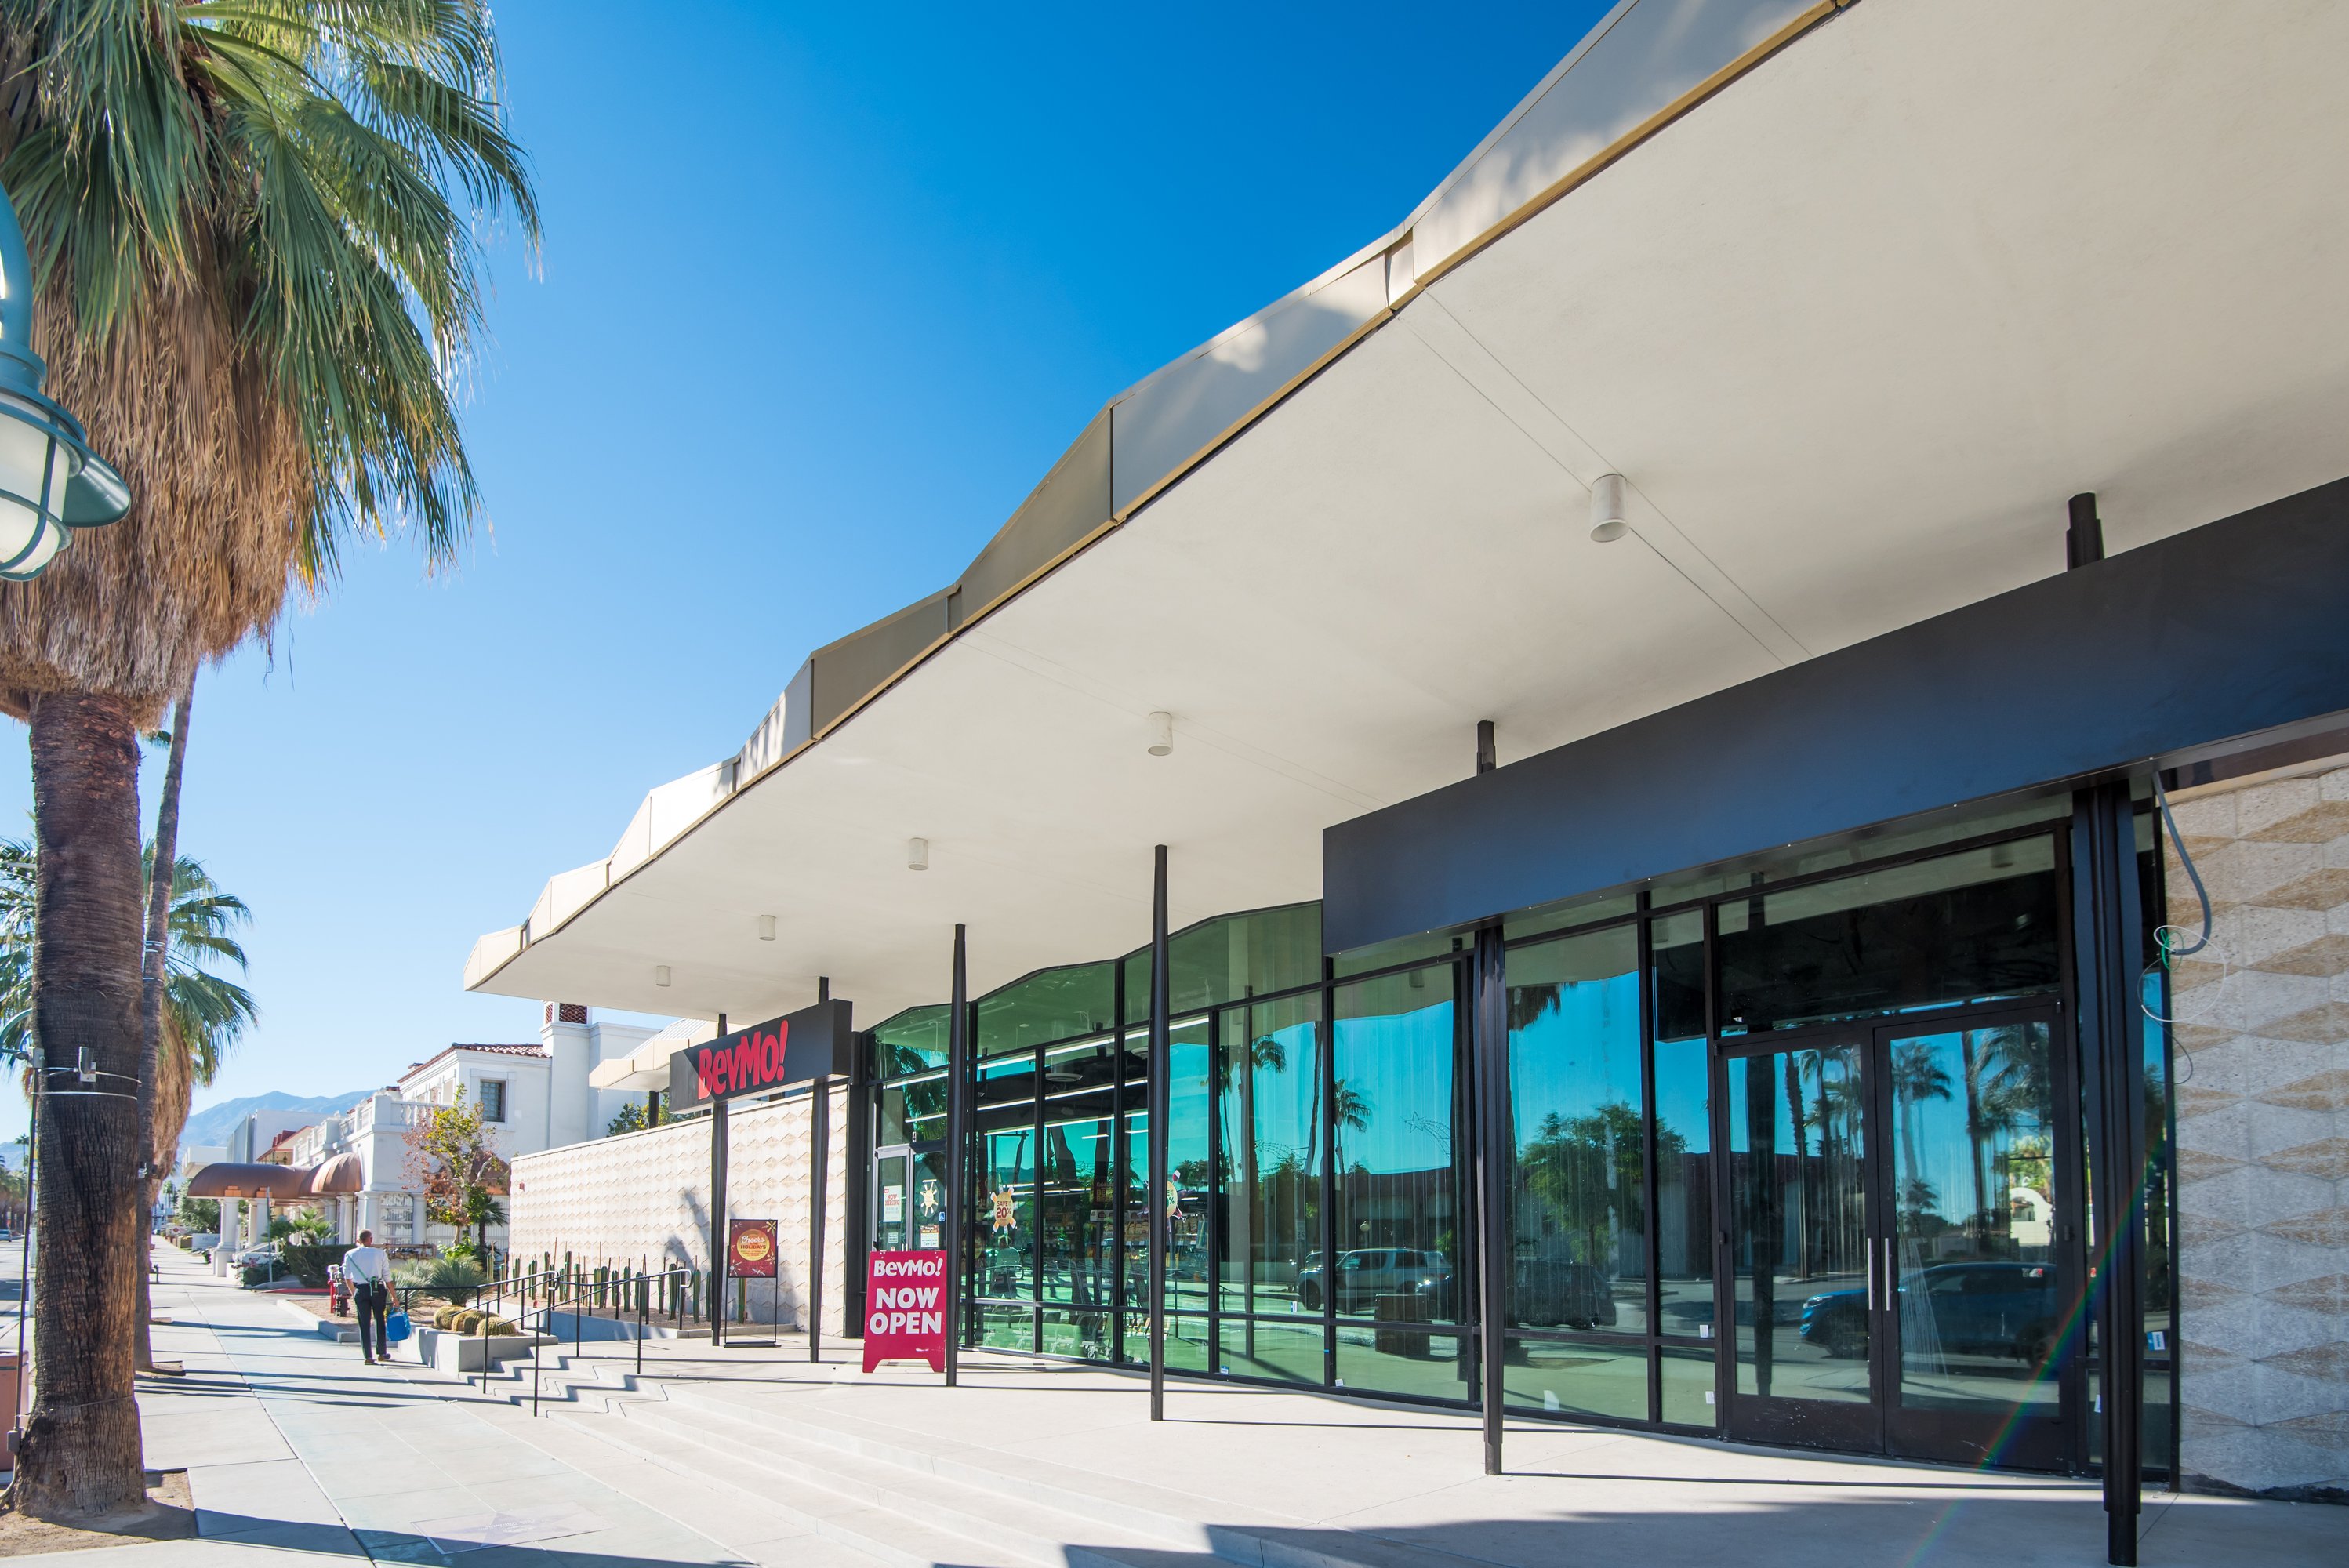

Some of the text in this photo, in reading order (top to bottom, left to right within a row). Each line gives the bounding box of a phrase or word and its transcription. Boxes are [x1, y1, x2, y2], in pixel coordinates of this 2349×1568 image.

[698, 1019, 789, 1100] BevMo!
[996, 1207, 1011, 1218] 20%
[873, 1258, 943, 1276] BevMo!
[876, 1287, 939, 1308] NOW
[870, 1312, 942, 1334] OPEN
